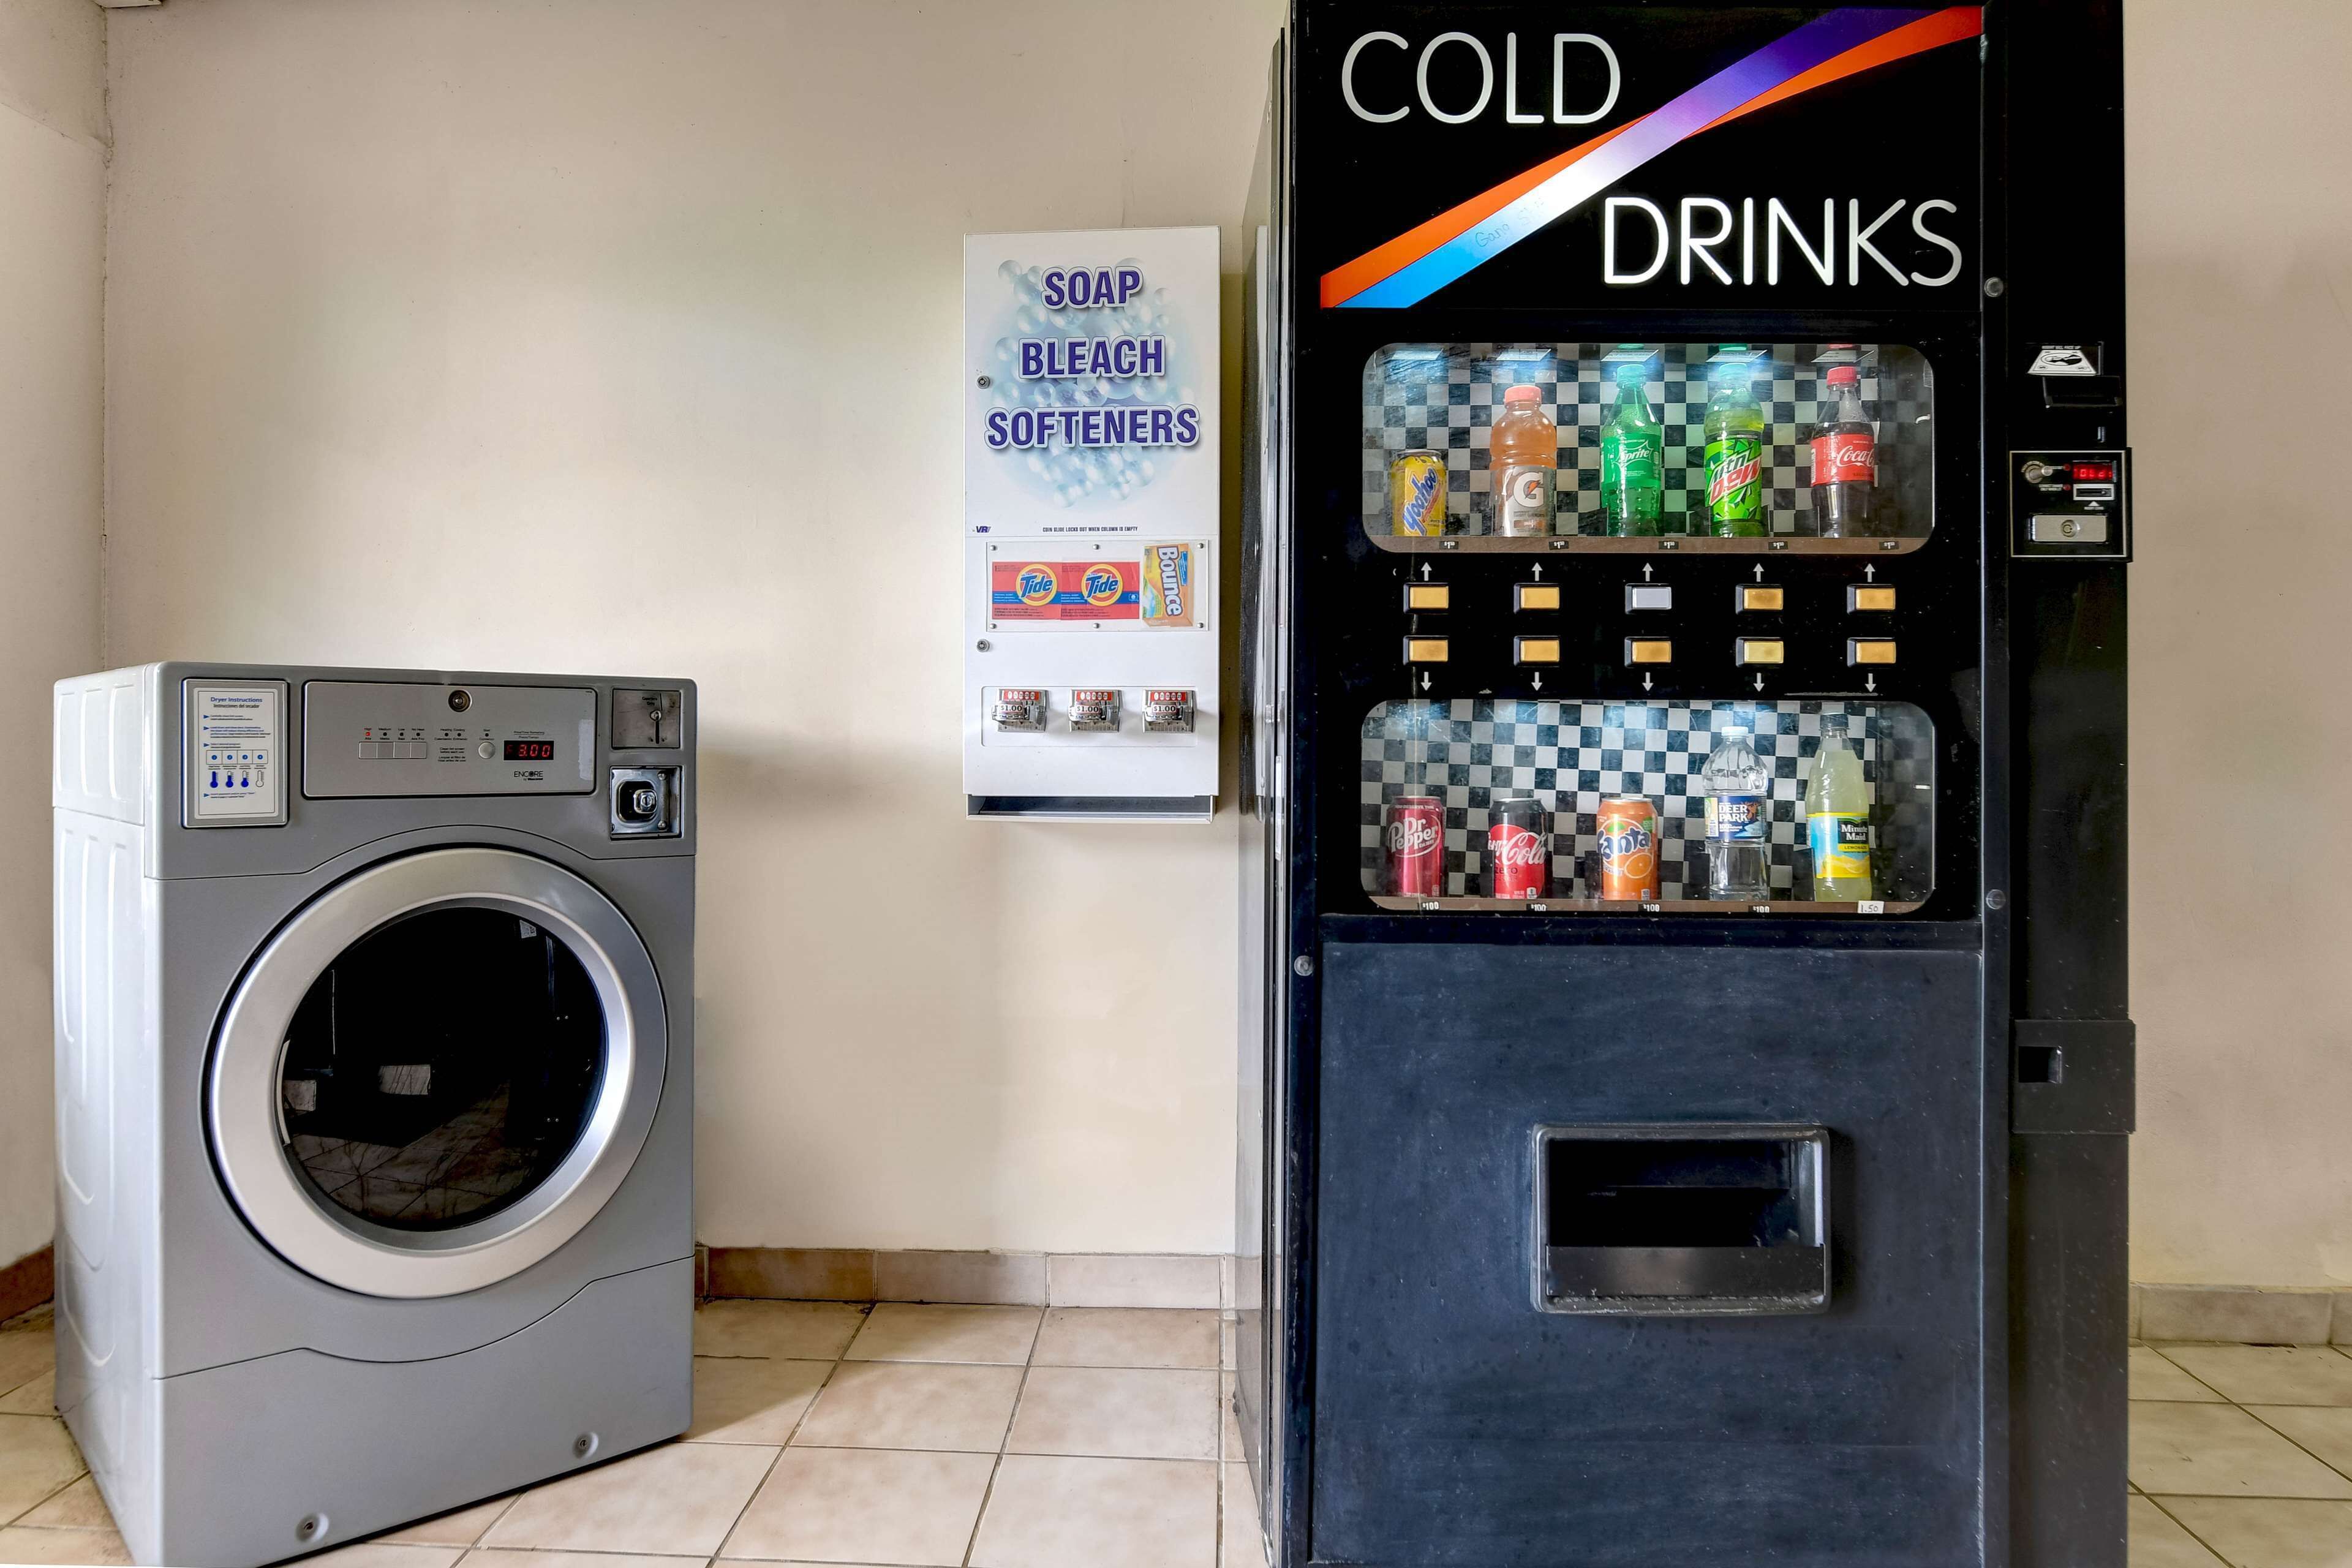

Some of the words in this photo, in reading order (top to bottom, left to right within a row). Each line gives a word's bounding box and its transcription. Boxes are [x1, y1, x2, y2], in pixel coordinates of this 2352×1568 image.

[1341, 31, 1621, 124] COLD
[1603, 197, 1962, 287] DRINKS
[1044, 268, 1142, 307] SOAP
[1021, 339, 1163, 376] BLEACH
[987, 407, 1198, 447] SOFTENERS
[1619, 448, 1649, 464] Sprite
[1513, 472, 1544, 507] G
[1020, 575, 1053, 598] Tide
[1085, 575, 1118, 598] Tide
[1156, 546, 1183, 616] Bounce
[1719, 804, 1748, 813] DEER
[1719, 813, 1749, 823] PARK
[1389, 826, 1438, 853] Pepper
[1404, 818, 1427, 834] Dr
[1860, 904, 1879, 913] 1.50
